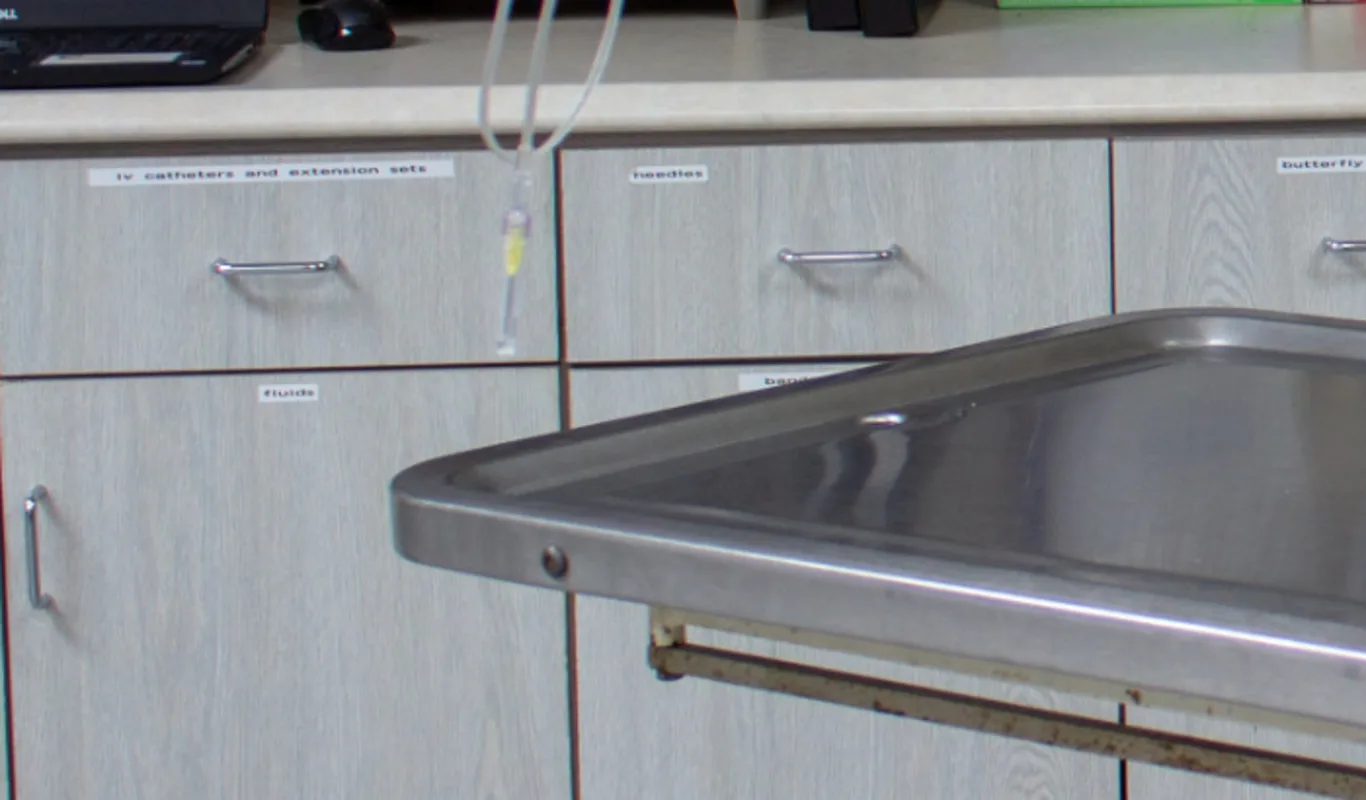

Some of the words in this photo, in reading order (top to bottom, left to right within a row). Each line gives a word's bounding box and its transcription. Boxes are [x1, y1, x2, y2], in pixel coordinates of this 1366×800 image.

[1280, 159, 1364, 169] butterfly
[144, 170, 234, 180] catheters
[245, 168, 279, 177] and
[288, 165, 380, 176] extension
[389, 164, 427, 174] sets
[633, 169, 704, 179] needles
[264, 388, 315, 398] fluids
